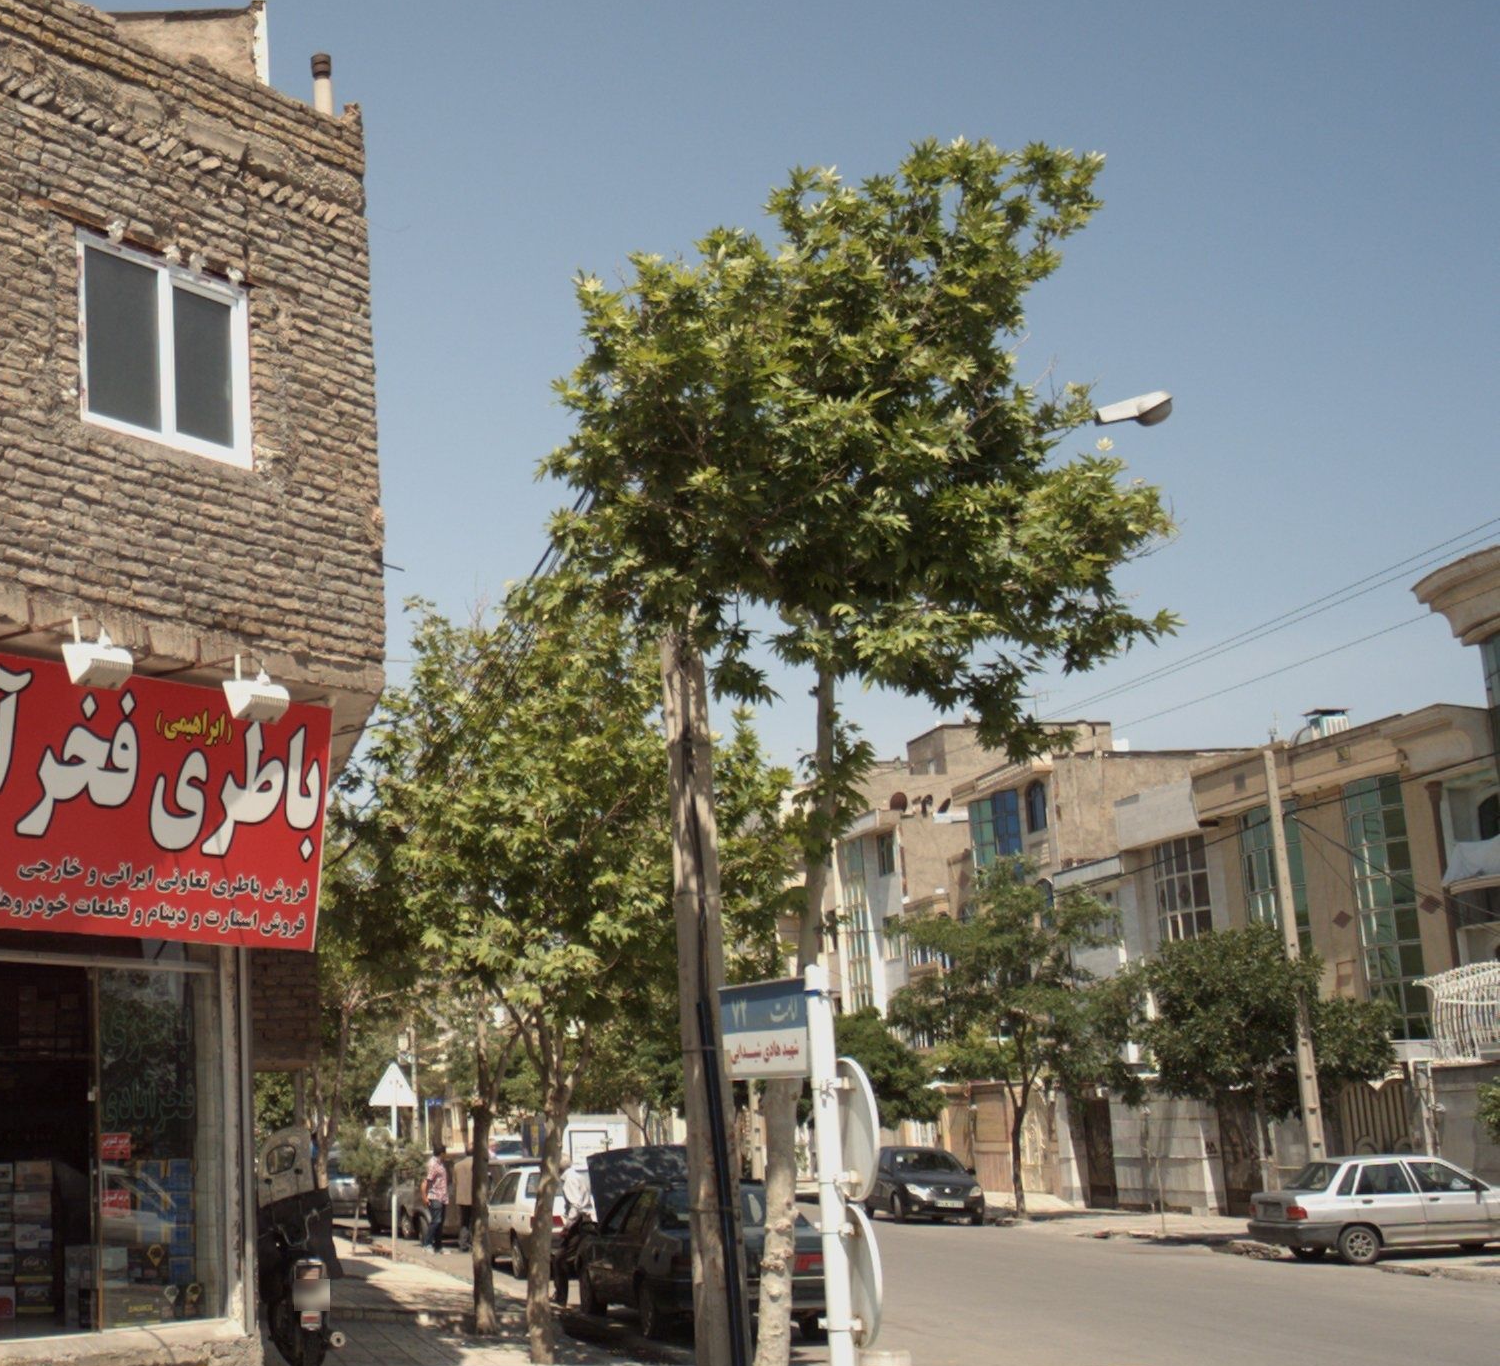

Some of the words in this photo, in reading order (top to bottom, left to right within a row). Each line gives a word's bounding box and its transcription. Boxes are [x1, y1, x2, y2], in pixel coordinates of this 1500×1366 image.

[149, 721, 322, 862] باطری
[18, 856, 83, 882] خارجی
[87, 868, 97, 885] و
[101, 862, 153, 890] ایرانی
[156, 870, 209, 894] تعاونی
[211, 876, 261, 899] باطری
[264, 879, 310, 903] فروش
[73, 896, 130, 918] قطعات
[132, 909, 142, 925] و
[146, 902, 187, 929] دینام
[190, 913, 200, 930] و
[204, 910, 258, 934] استارت
[260, 912, 306, 937] فروش
